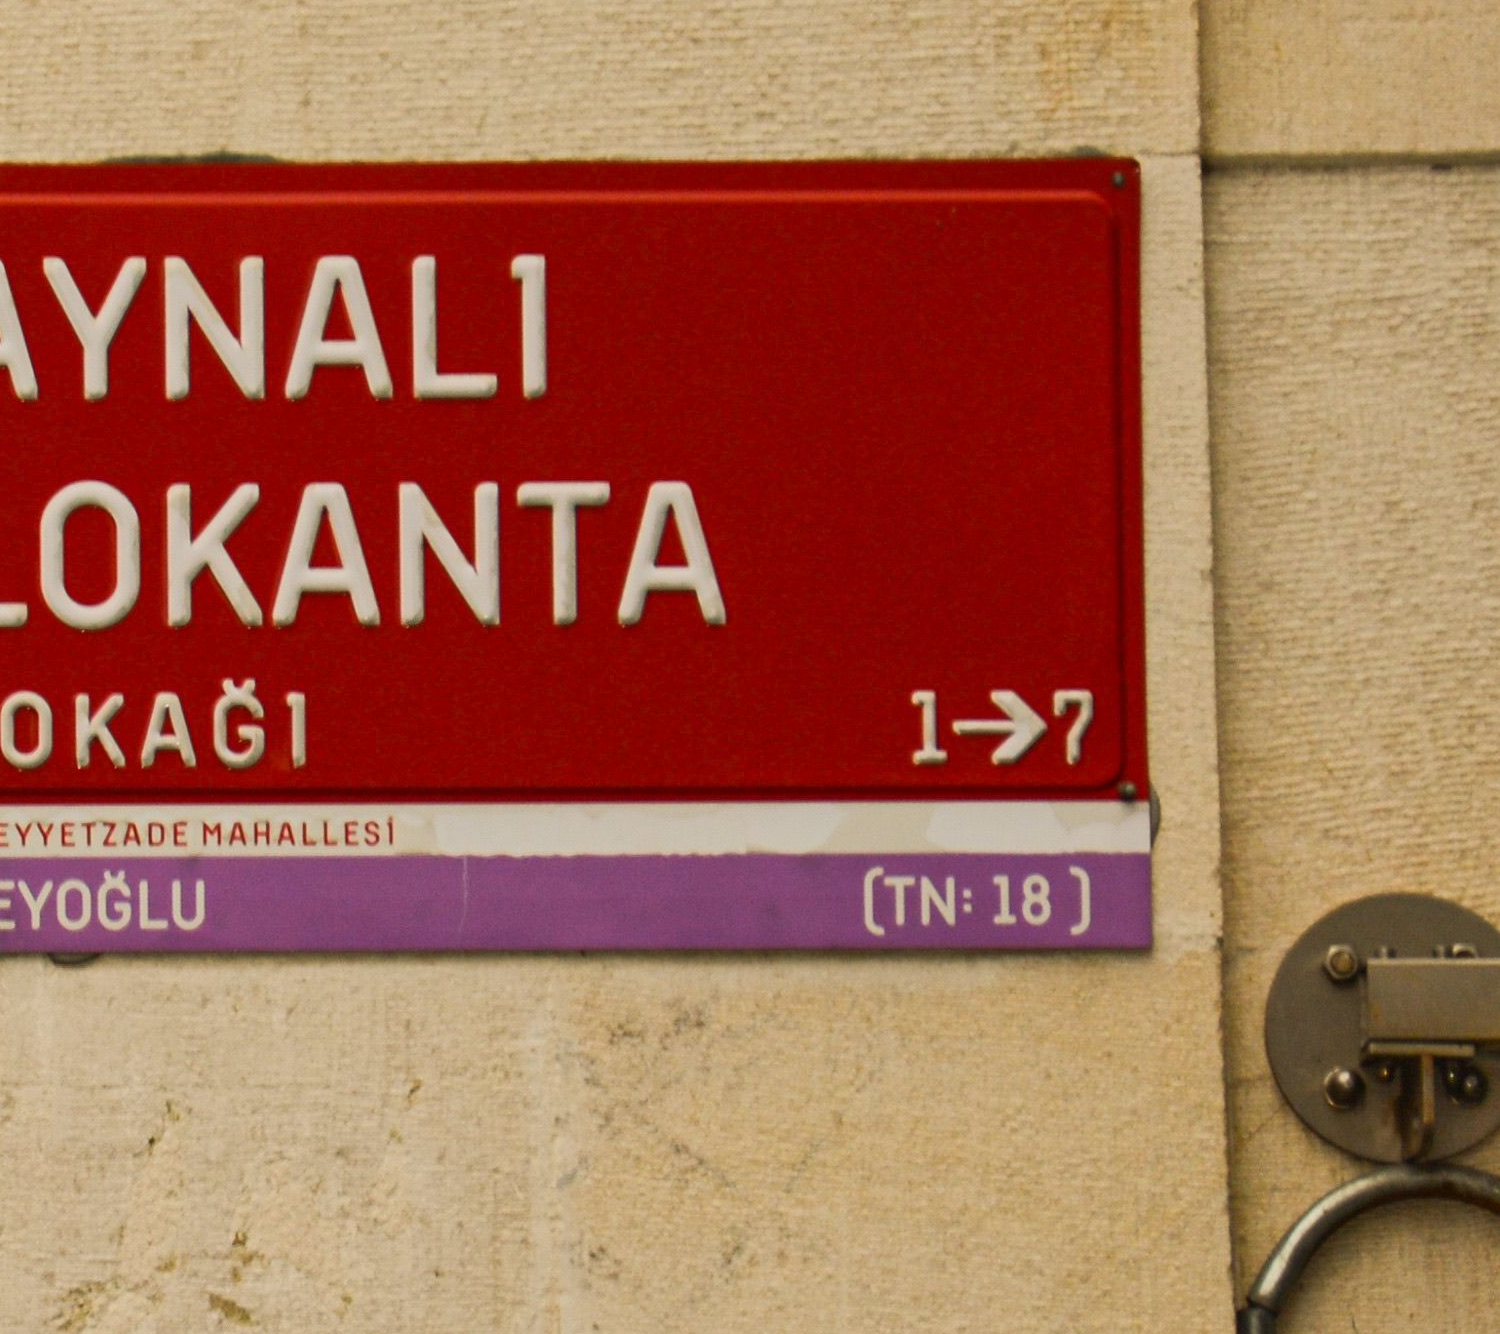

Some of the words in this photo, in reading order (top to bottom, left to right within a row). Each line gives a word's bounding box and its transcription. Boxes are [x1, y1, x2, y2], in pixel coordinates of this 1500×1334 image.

[912, 690, 948, 765] 1
[1053, 689, 1093, 765] 7
[202, 816, 394, 846] MAHALLESİ
